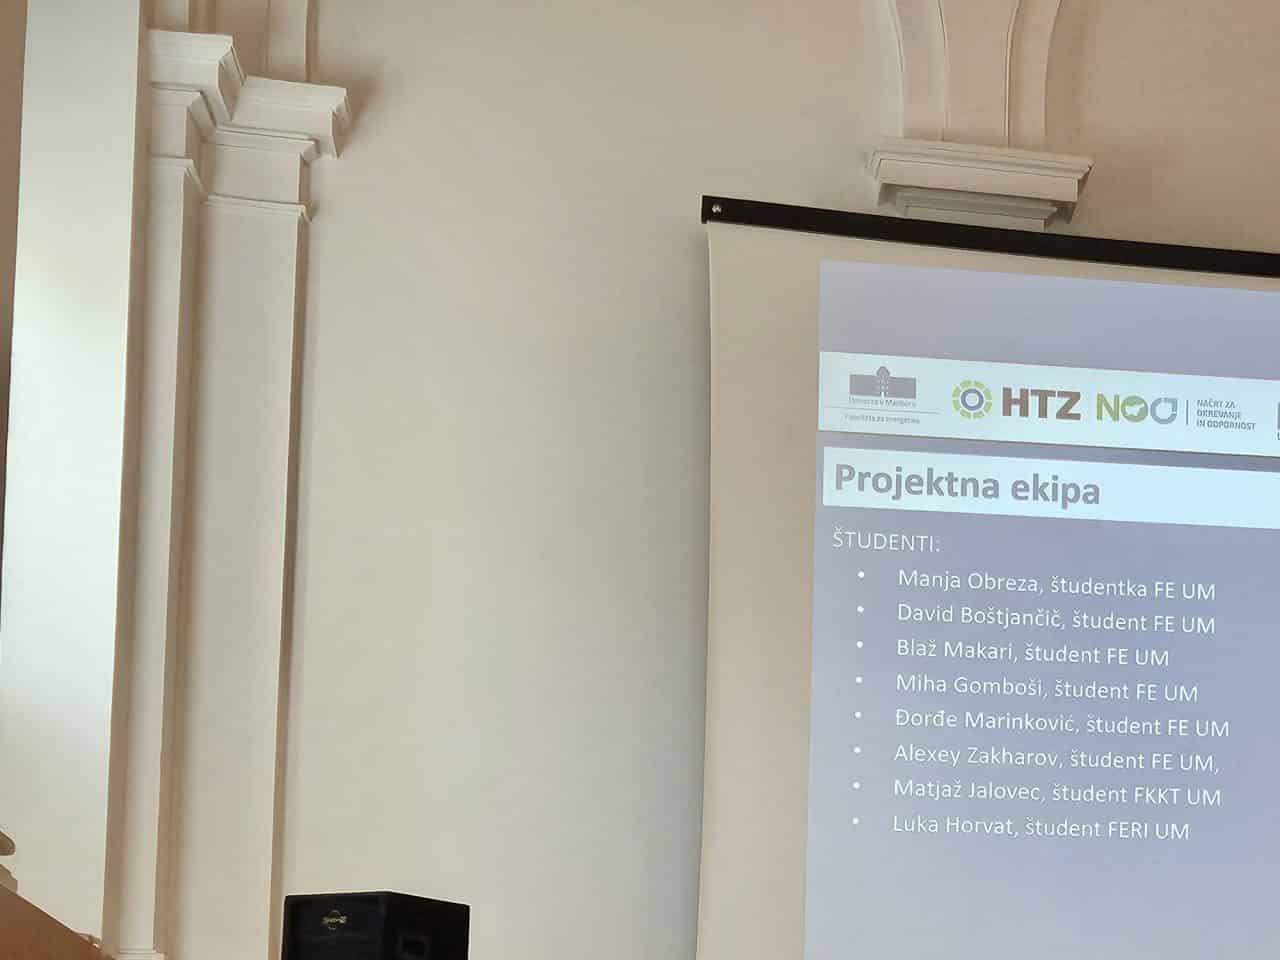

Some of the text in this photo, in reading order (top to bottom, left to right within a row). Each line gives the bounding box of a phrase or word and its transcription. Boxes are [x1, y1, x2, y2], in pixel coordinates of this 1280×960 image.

[1002, 387, 1081, 420] HTZ
[1196, 399, 1235, 409] NAČRT ZA
[1197, 410, 1241, 420] OKREVANJE
[1197, 419, 1256, 430] IN ODPORNOST
[834, 463, 1101, 510] Projektna ekipa
[832, 526, 941, 553] ŠTUDENTI:
[898, 569, 1216, 600] Manja Obreza, študentka FE UM
[897, 603, 1216, 634] David Boštjančič, študent FE UM
[896, 638, 1170, 667] Blaž Makari, študent FE UM
[896, 674, 1199, 702] Miha Gomboši, študent FE UM
[895, 709, 1230, 737] Đorđe Marinković, študent FE UM
[895, 744, 1219, 774] Alexey Zakharov, študent FE UM,
[894, 778, 1222, 806] Matjaž Jalovec, študent FKKT UM
[893, 815, 1190, 840] Luka Horvat, študent FERI UM
